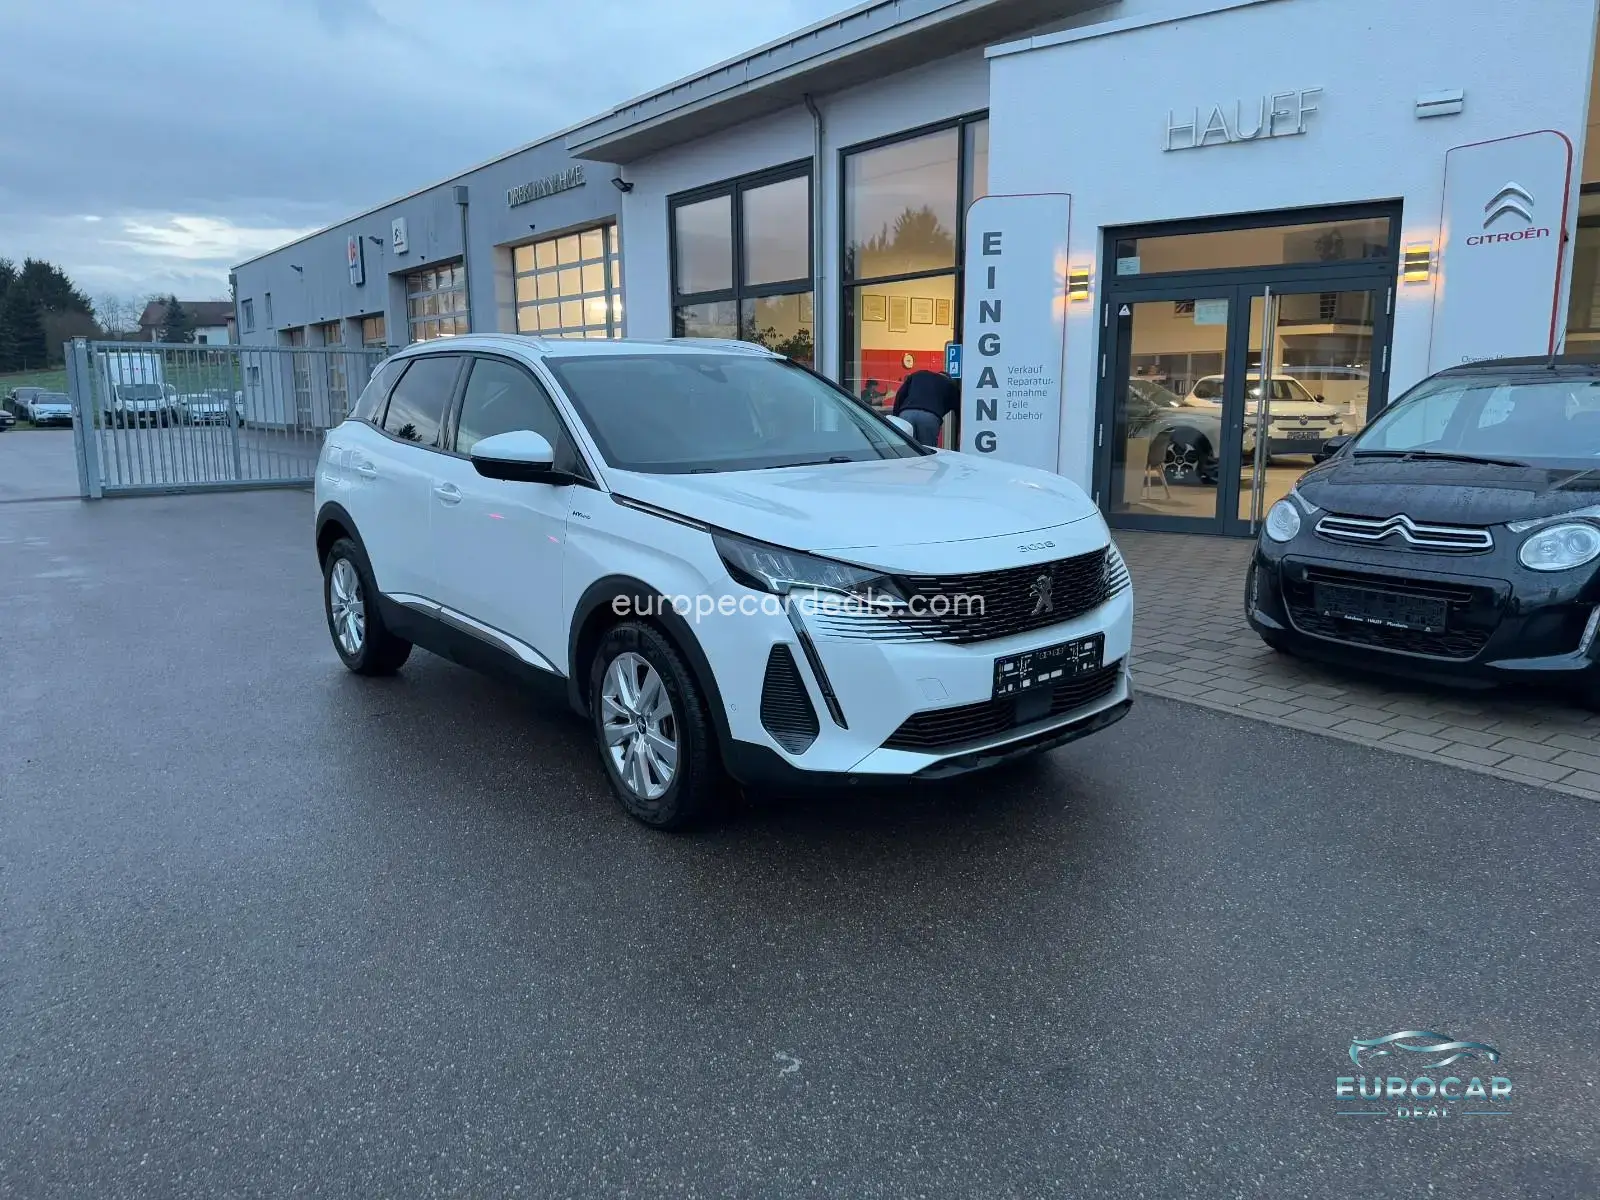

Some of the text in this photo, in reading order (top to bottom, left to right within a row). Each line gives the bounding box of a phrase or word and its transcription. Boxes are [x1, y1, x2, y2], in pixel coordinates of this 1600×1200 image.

[1162, 88, 1323, 152] HAUFF
[974, 231, 1002, 453] EINGANG
[949, 348, 956, 361] P
[1007, 365, 1043, 374] Verkauf
[1006, 389, 1047, 398] annahme
[1007, 400, 1028, 409] Teile
[1006, 411, 1043, 421] Zubehör
